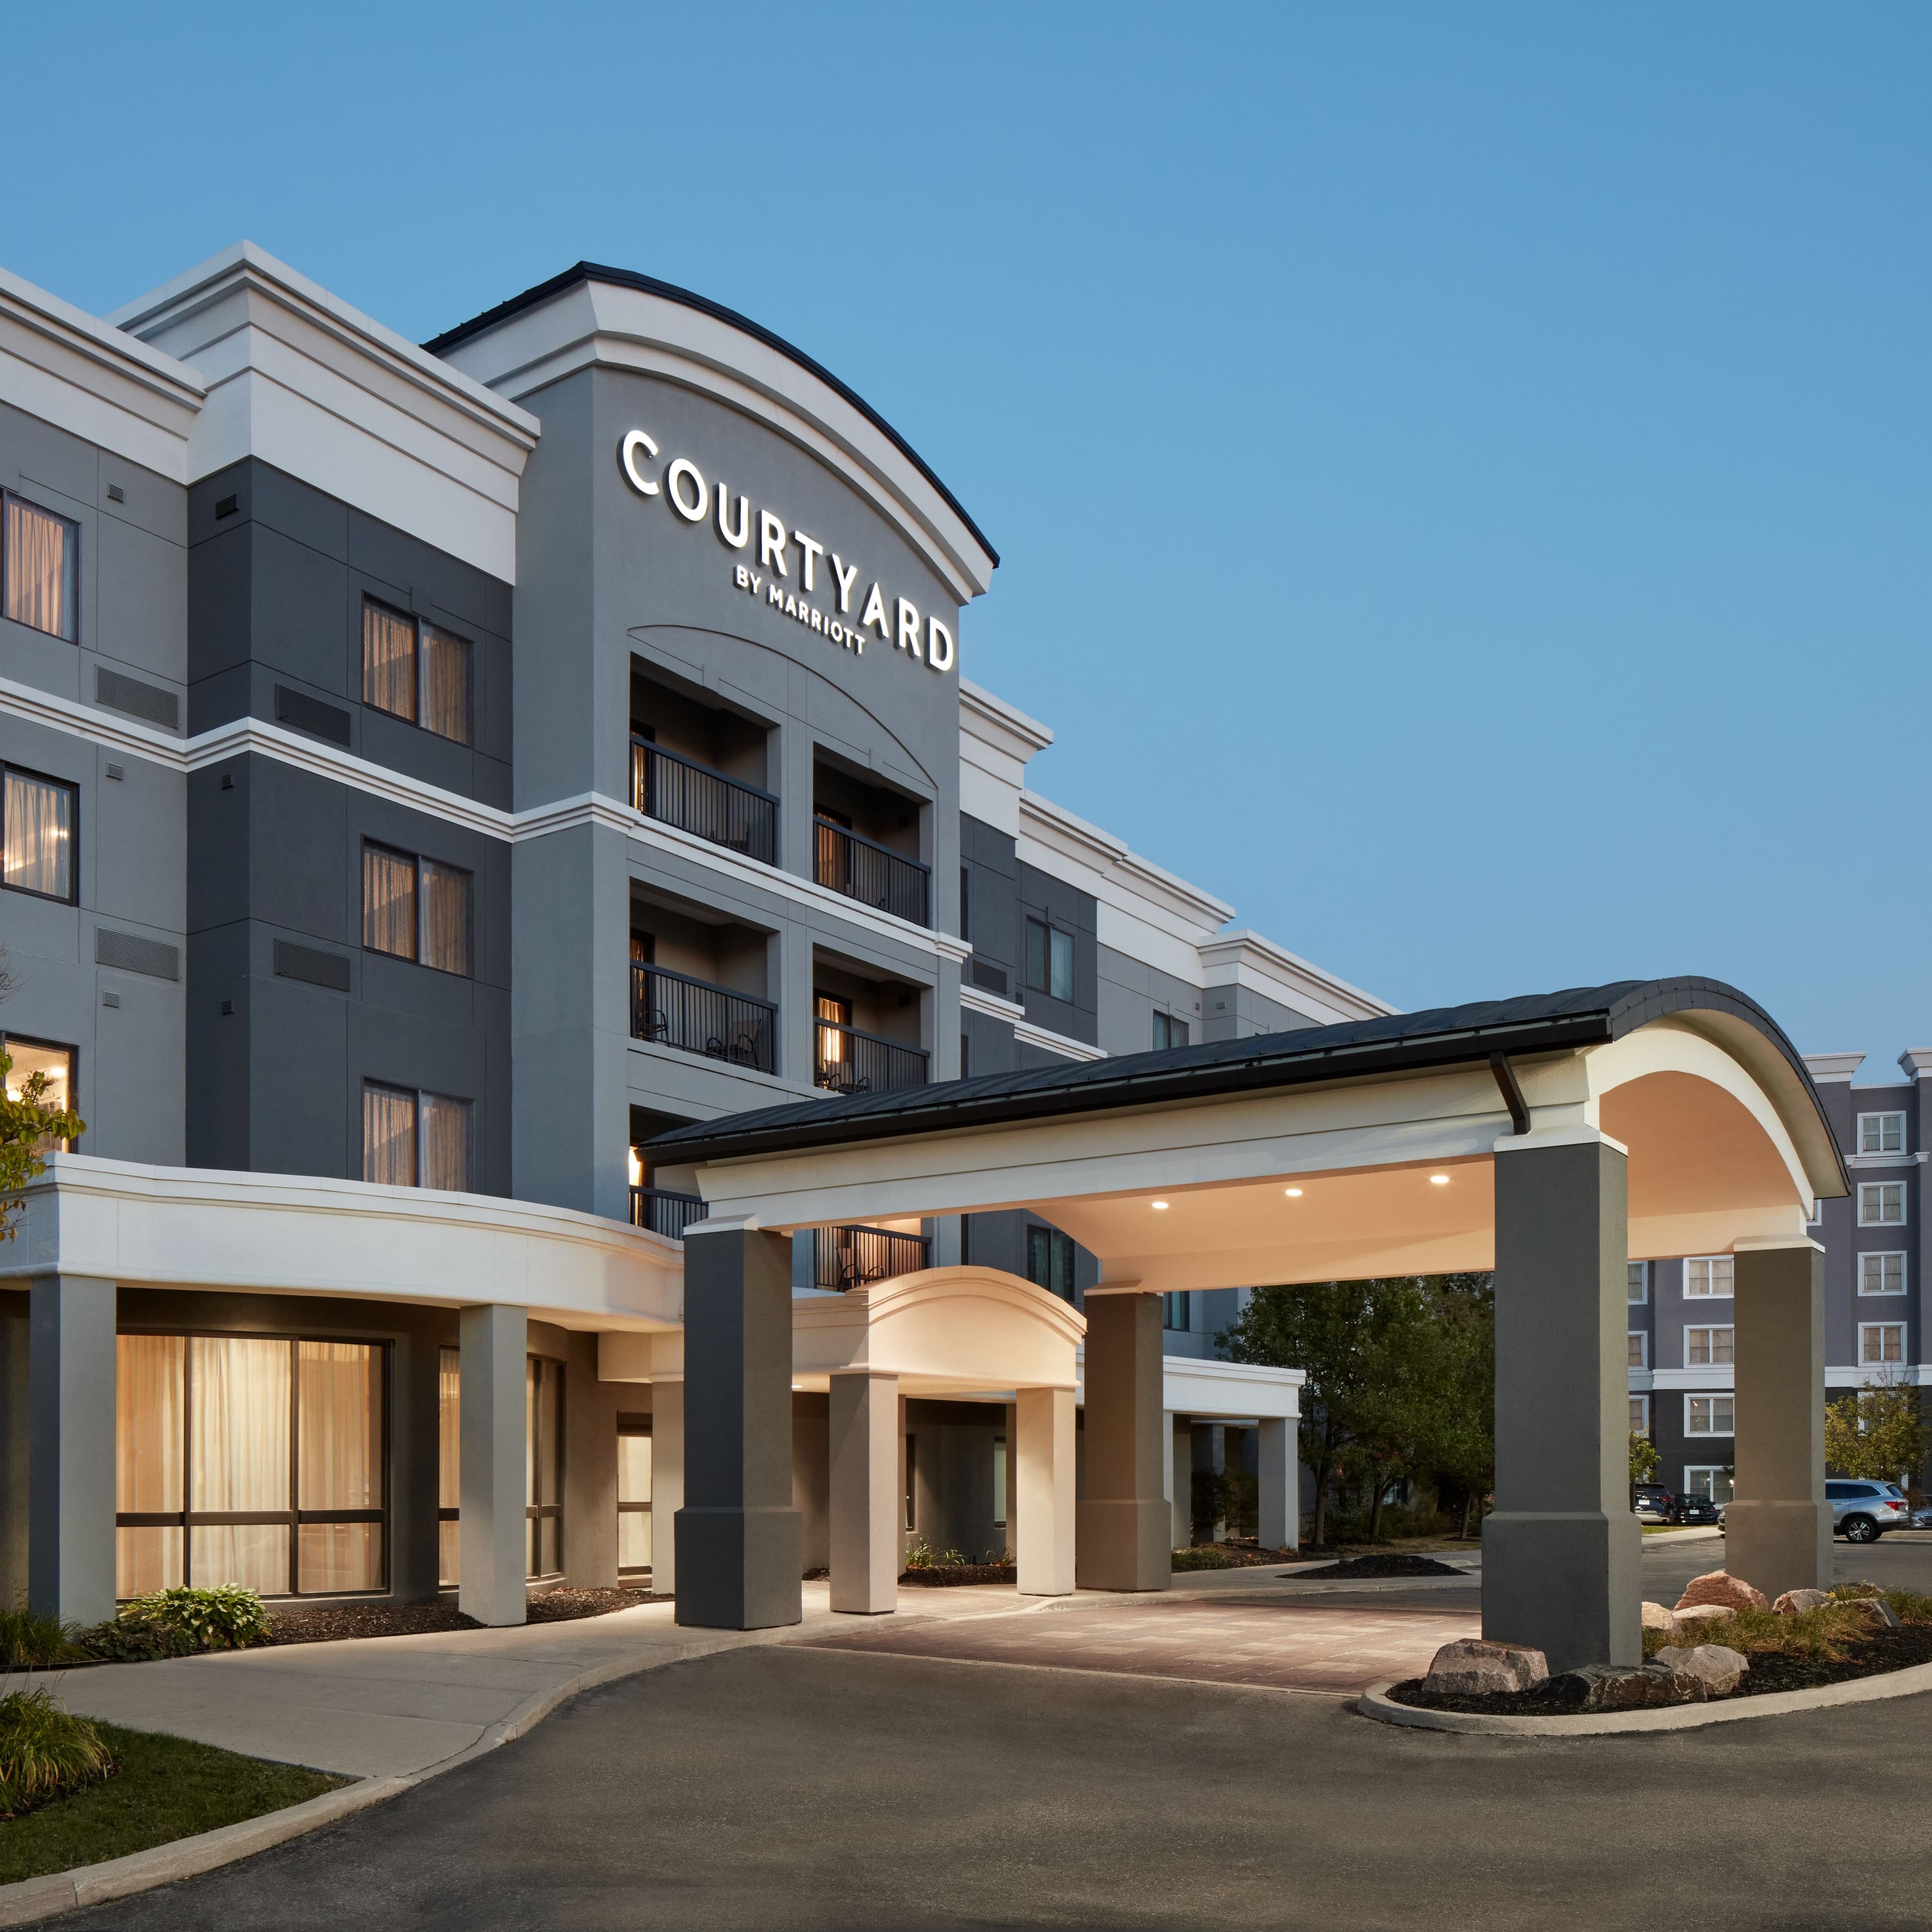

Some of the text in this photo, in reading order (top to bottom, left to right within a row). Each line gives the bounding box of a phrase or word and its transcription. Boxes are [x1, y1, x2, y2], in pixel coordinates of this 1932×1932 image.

[621, 430, 954, 671] COURTYARD
[735, 565, 865, 655] BY MARRIOTT
